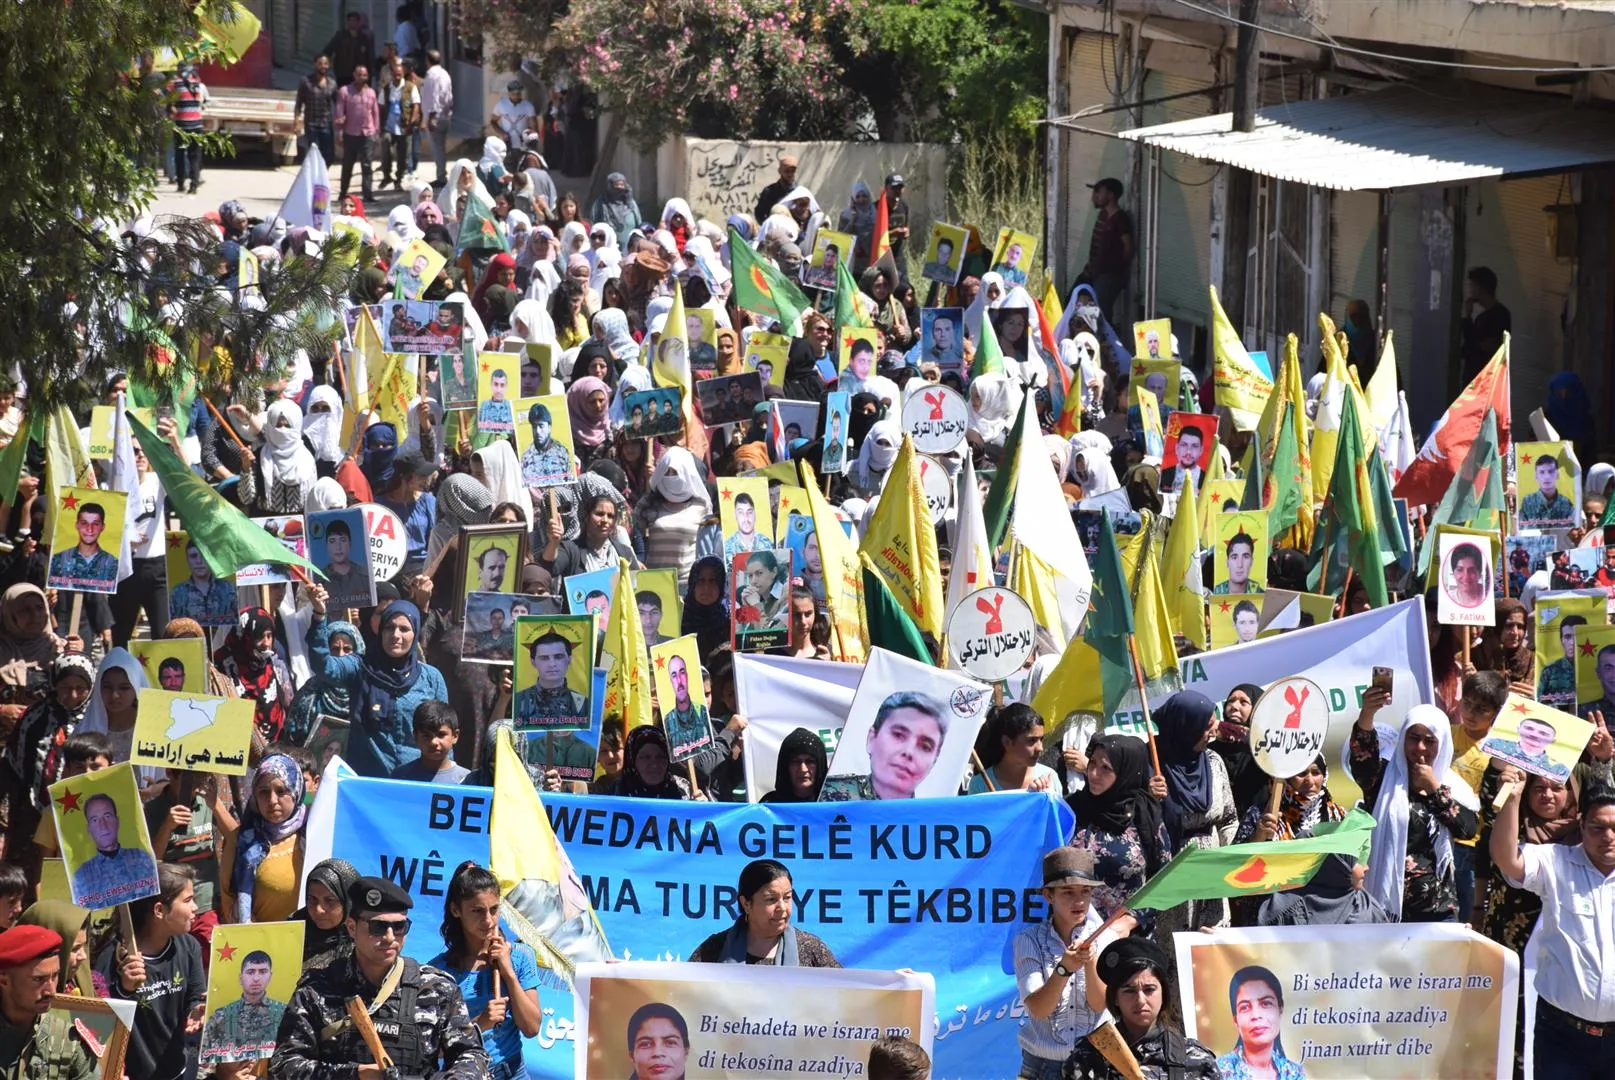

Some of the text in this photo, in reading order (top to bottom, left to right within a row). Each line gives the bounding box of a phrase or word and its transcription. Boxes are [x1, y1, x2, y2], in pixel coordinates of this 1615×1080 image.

[923, 390, 946, 420] لا
[371, 551, 399, 567] ERIYA
[976, 592, 1004, 635] لا
[960, 638, 992, 667] التركي
[1284, 684, 1310, 729] لا
[137, 740, 244, 769] قسد هي إرادتنا
[1254, 729, 1286, 756] التركي
[738, 814, 853, 860] GELÊ
[869, 823, 992, 860] KURD
[380, 849, 445, 897] WÊ
[858, 879, 1054, 924] TÊKBIBE
[1293, 972, 1492, 992] Bi sehadeta we israra me
[373, 1022, 400, 1036] WARI
[699, 1014, 719, 1033] Bi
[722, 1016, 798, 1037] sehadeta
[803, 1023, 828, 1038] we
[831, 1021, 880, 1040] israra
[1292, 1007, 1308, 1025] di
[1385, 1006, 1448, 1028] azadiya
[698, 1050, 715, 1069] di
[798, 1056, 864, 1080] azadiya
[1299, 1038, 1433, 1064] jinan xurtir dibe
